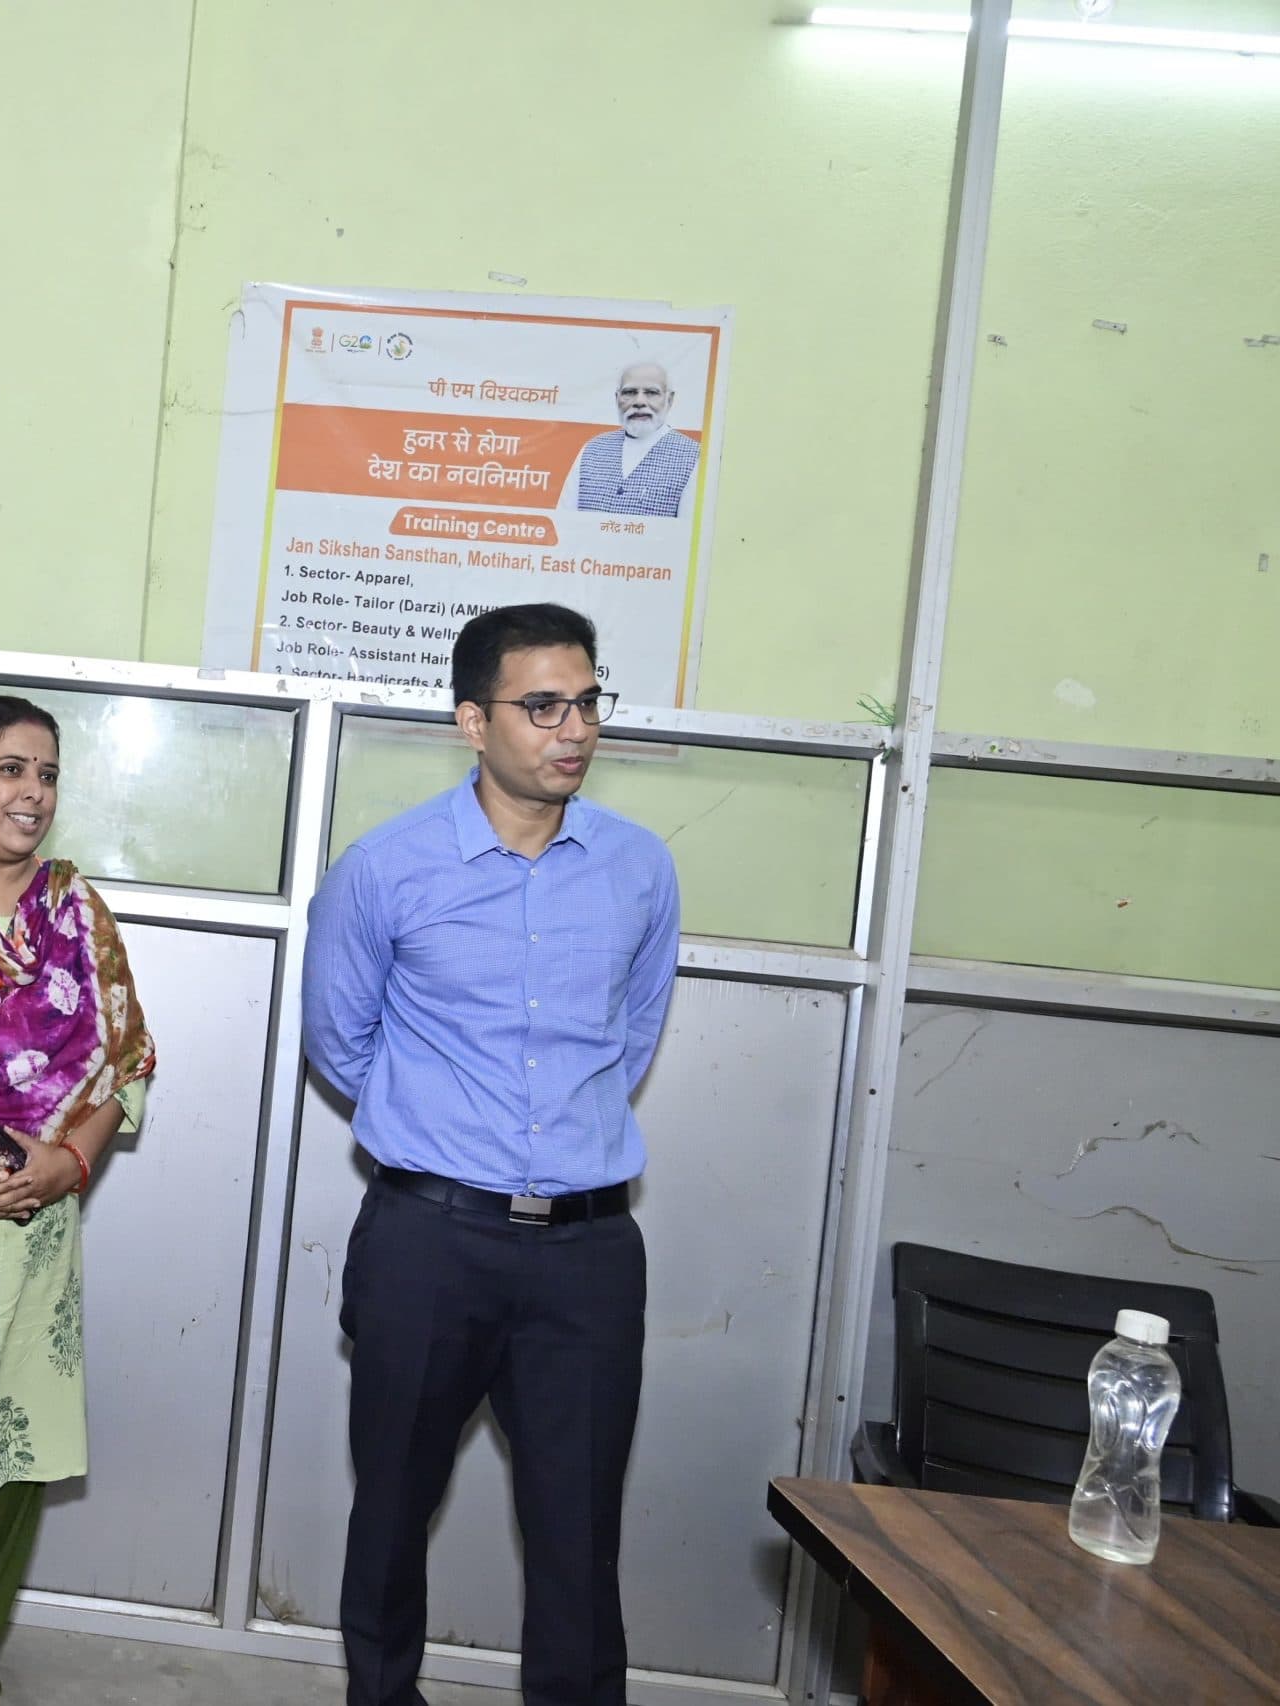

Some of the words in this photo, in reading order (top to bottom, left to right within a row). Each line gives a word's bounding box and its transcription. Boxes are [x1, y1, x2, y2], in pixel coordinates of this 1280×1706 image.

[428, 378, 448, 397] पी
[451, 383, 475, 398] एम
[480, 380, 559, 404] विश्वकर्मा
[403, 429, 448, 455] हुनर
[451, 428, 472, 453] से
[477, 429, 520, 456] होगा
[368, 454, 403, 481] देश
[408, 462, 441, 483] का
[445, 461, 550, 491] नवनिर्माण
[403, 513, 479, 539] Training
[483, 520, 546, 538] Centre
[286, 537, 313, 554] Jan
[319, 539, 380, 559] Sikshan
[385, 544, 462, 567] Sansthan,
[467, 551, 535, 573] Motihari,
[540, 555, 576, 574] East
[580, 558, 672, 581] Champaran
[284, 565, 294, 577] 1.
[299, 566, 351, 580] Sector-
[354, 570, 414, 587] Apparel,
[281, 590, 308, 603] Job
[312, 592, 349, 606] Role-
[354, 595, 395, 610] Tailor
[399, 599, 446, 616] (Darzi)
[450, 603, 498, 617] (AMH
[280, 615, 291, 627] 2.
[296, 616, 347, 631] Sector-
[352, 621, 401, 638] Beauty
[406, 625, 416, 637] &
[421, 626, 460, 640] Welln
[276, 641, 303, 654] Job
[307, 643, 344, 656] Role-
[348, 646, 416, 663] Assistant
[421, 652, 450, 665] Hair
[597, 665, 610, 681] 5)
